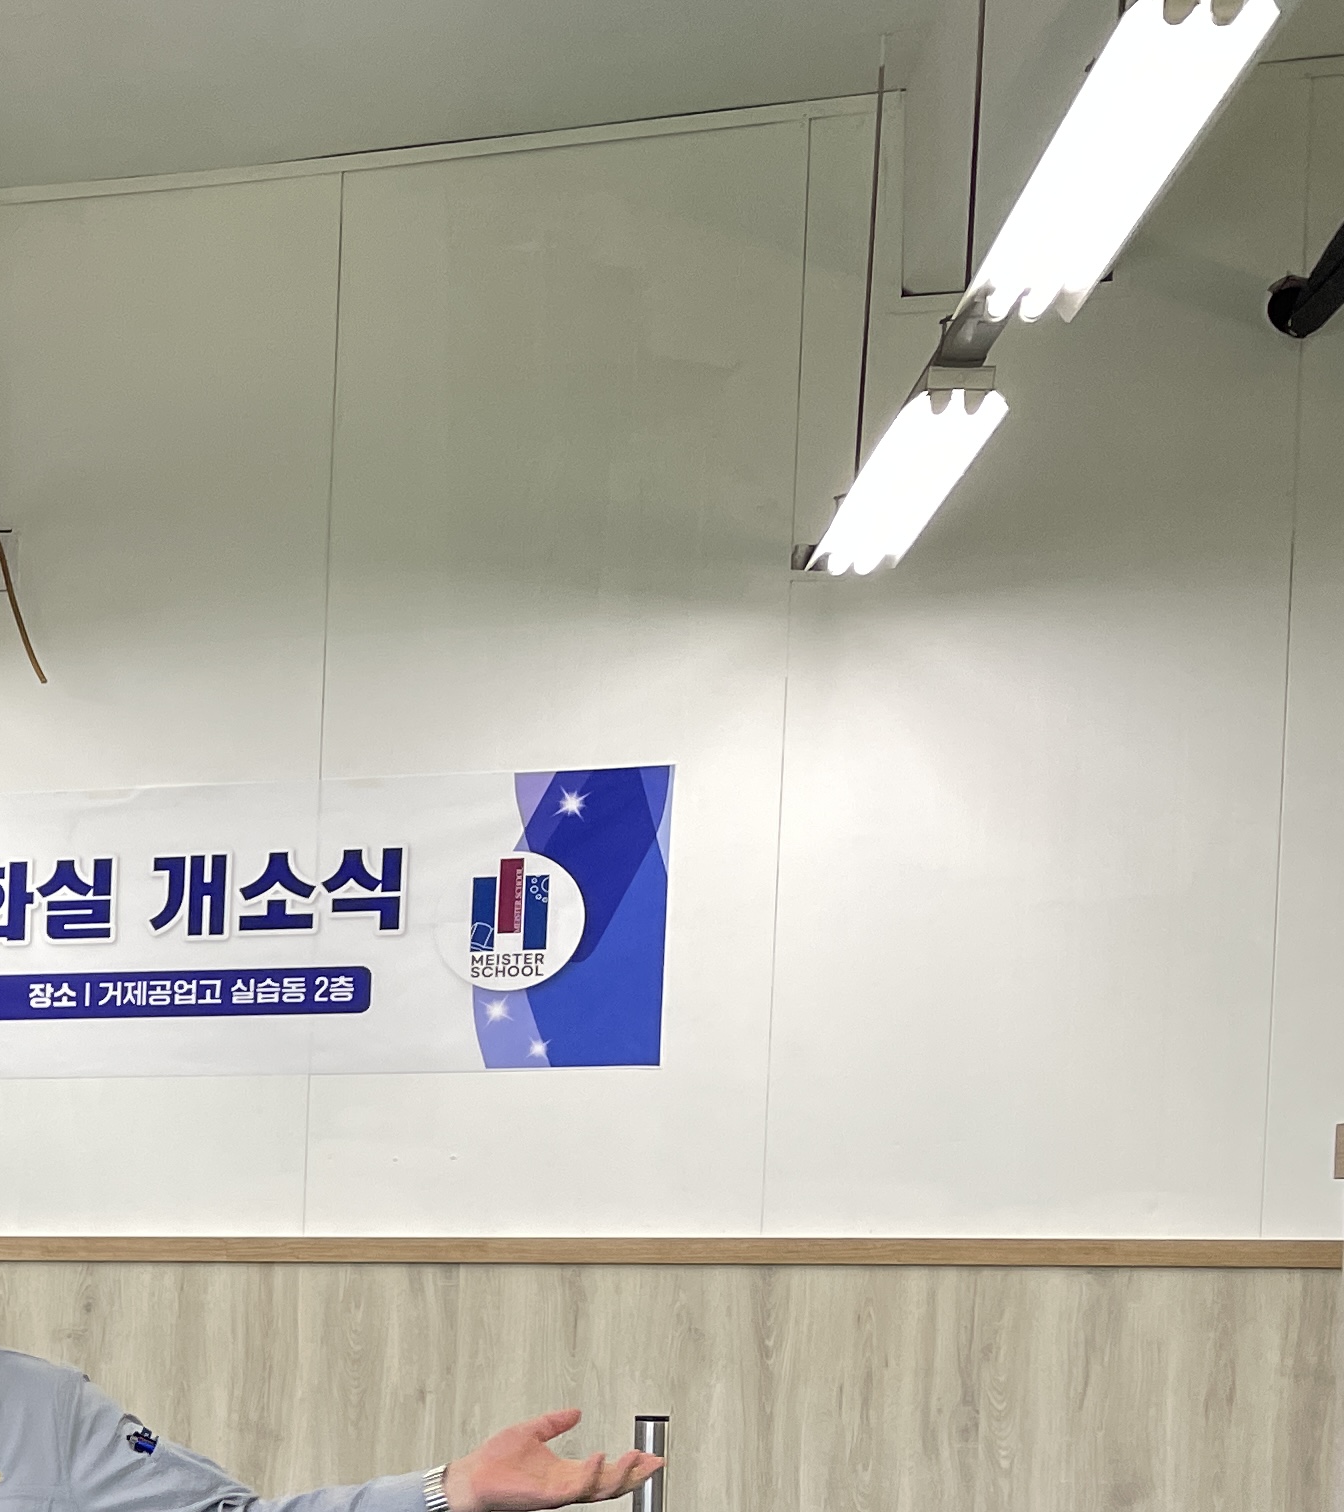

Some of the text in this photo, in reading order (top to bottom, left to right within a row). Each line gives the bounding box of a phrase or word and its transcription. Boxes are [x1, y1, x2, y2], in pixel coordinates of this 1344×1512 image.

[149, 847, 404, 936] 개소식
[470, 953, 545, 966] MEISTER
[470, 965, 544, 978] SCHOOL
[28, 982, 78, 1009] 장소
[98, 979, 222, 1007] 거제공업고
[230, 977, 307, 1004] 실습동
[314, 975, 355, 1003] 2층
